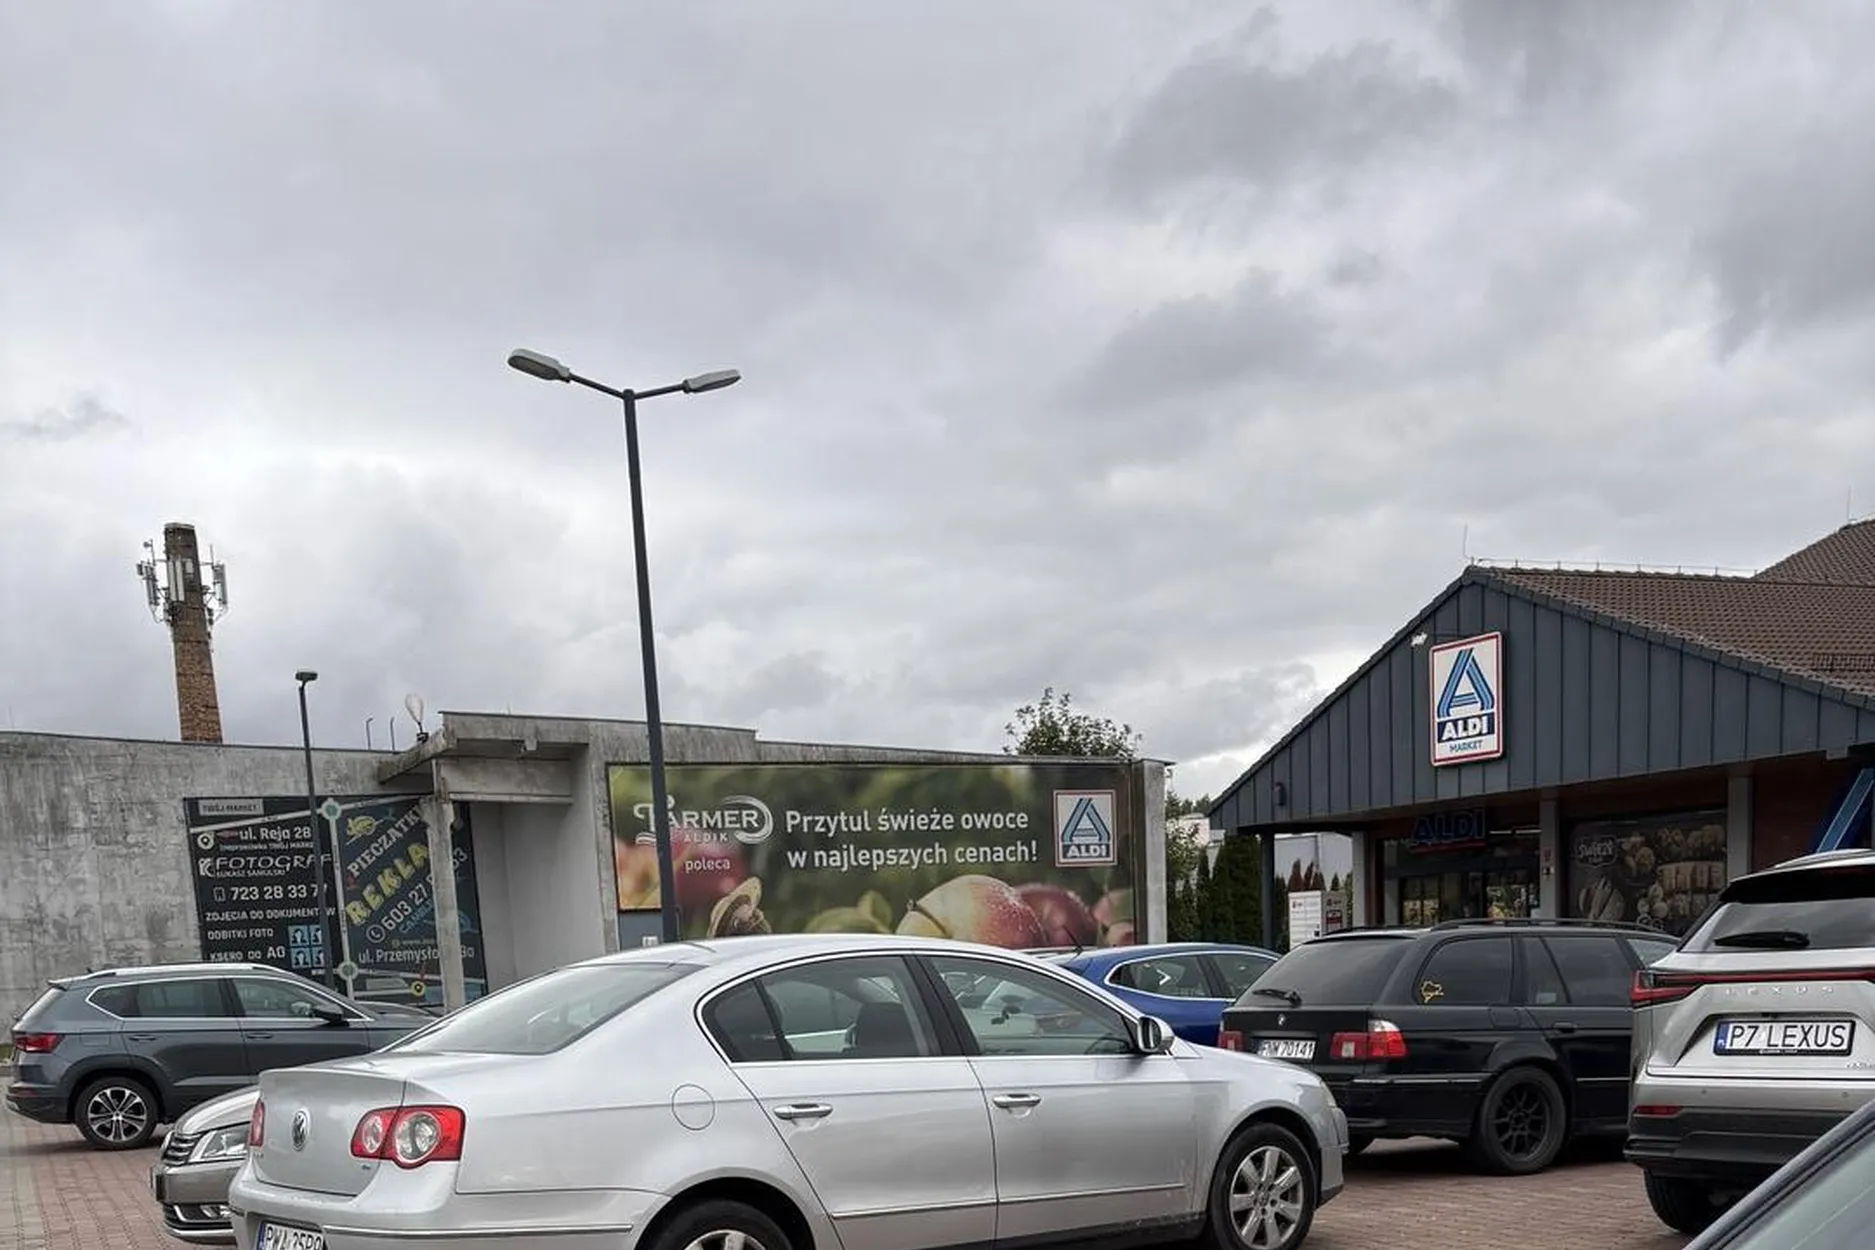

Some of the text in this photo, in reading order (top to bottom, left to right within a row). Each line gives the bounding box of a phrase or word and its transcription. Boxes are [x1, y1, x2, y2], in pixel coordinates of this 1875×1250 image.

[1441, 716, 1489, 741] ALDI
[1449, 740, 1483, 753] MARKET
[785, 807, 1029, 837] Przytul świeże owoce
[1410, 808, 1487, 845] ALDI
[239, 826, 312, 841] ul. Reja 28
[787, 839, 1038, 872] w najlepszych cenach!
[1067, 845, 1107, 858] ALDI
[685, 858, 731, 874] poleca
[230, 885, 259, 900] 723
[263, 885, 283, 900] 28
[287, 884, 307, 898] 33
[265, 907, 336, 920] DOKUMENTW
[381, 883, 428, 931] 603 27
[249, 928, 274, 939] FOTO
[210, 950, 243, 961] KSERO
[247, 950, 262, 959] DO
[358, 948, 374, 964] ul.
[375, 945, 440, 964] Przemysło
[1729, 1023, 1847, 1048] P7 LEXUS
